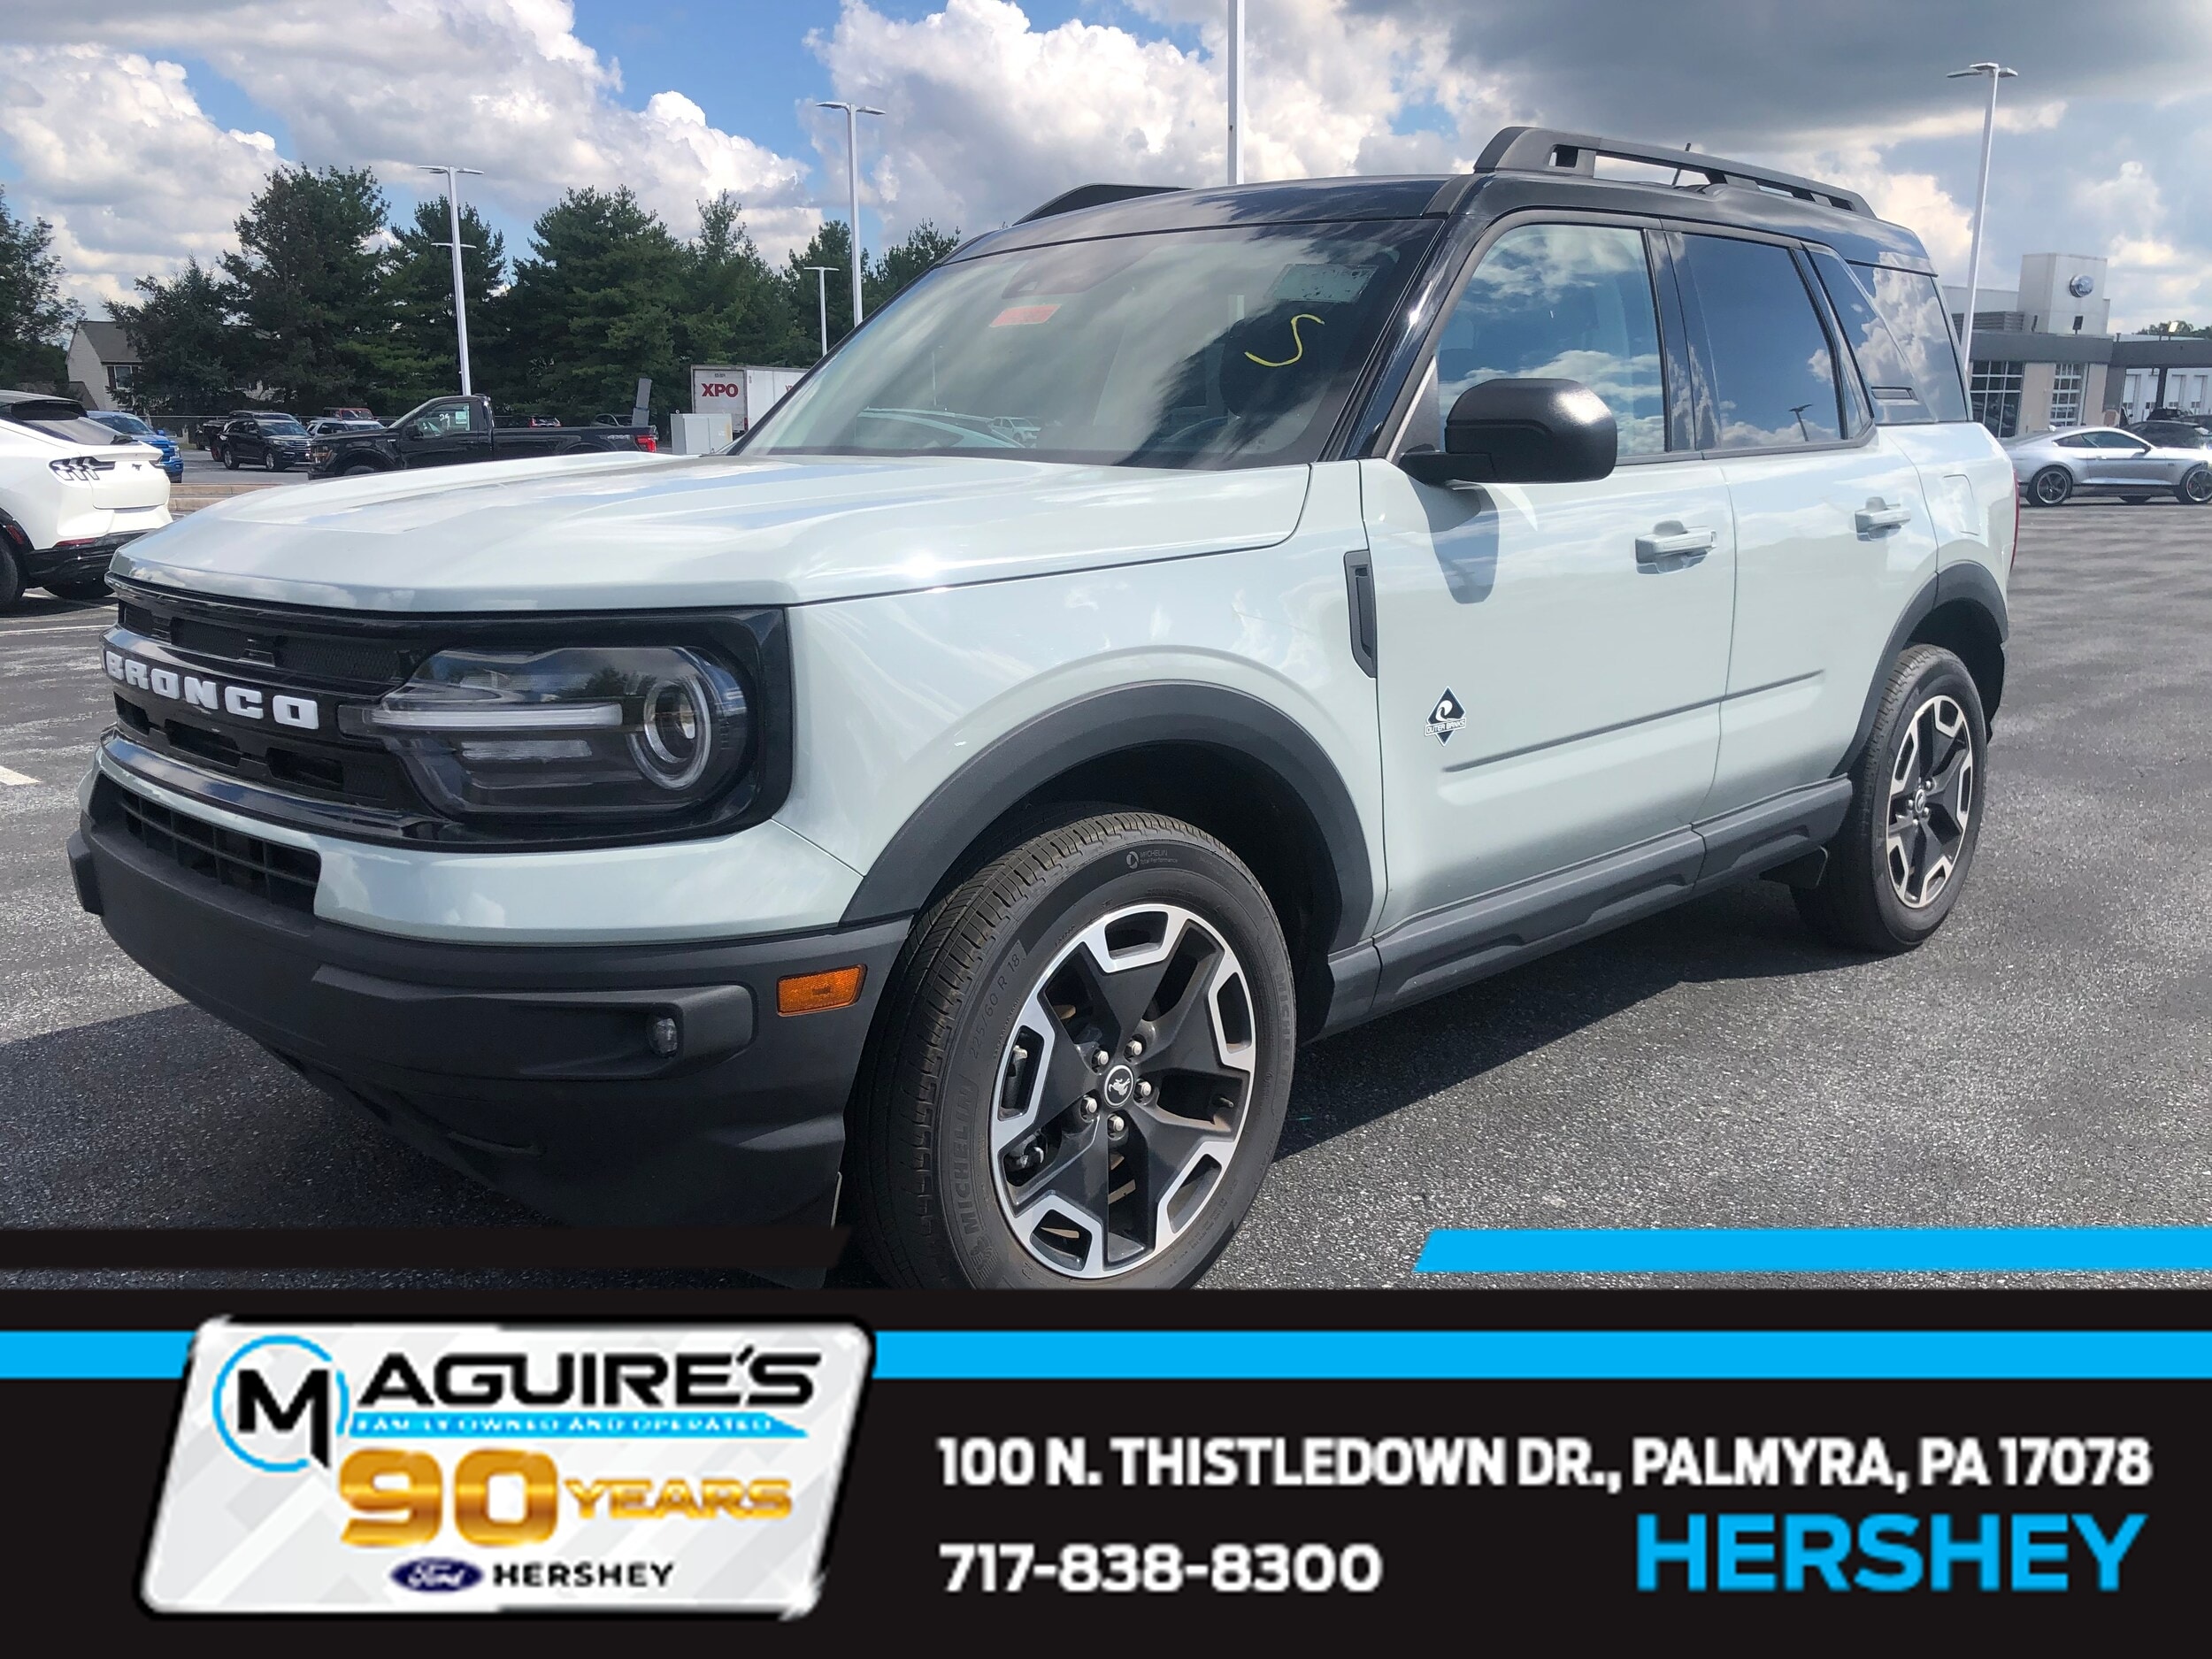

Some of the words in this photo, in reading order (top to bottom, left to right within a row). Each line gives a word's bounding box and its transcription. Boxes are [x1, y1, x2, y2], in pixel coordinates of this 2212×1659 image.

[701, 382, 740, 398] XPO
[105, 650, 319, 731] BRONCO
[1426, 724, 1446, 733] OUTER
[970, 993, 1000, 1060] 225/60
[997, 975, 1009, 991] R
[1007, 953, 1021, 972] 18
[953, 1086, 980, 1235] MICHELIN
